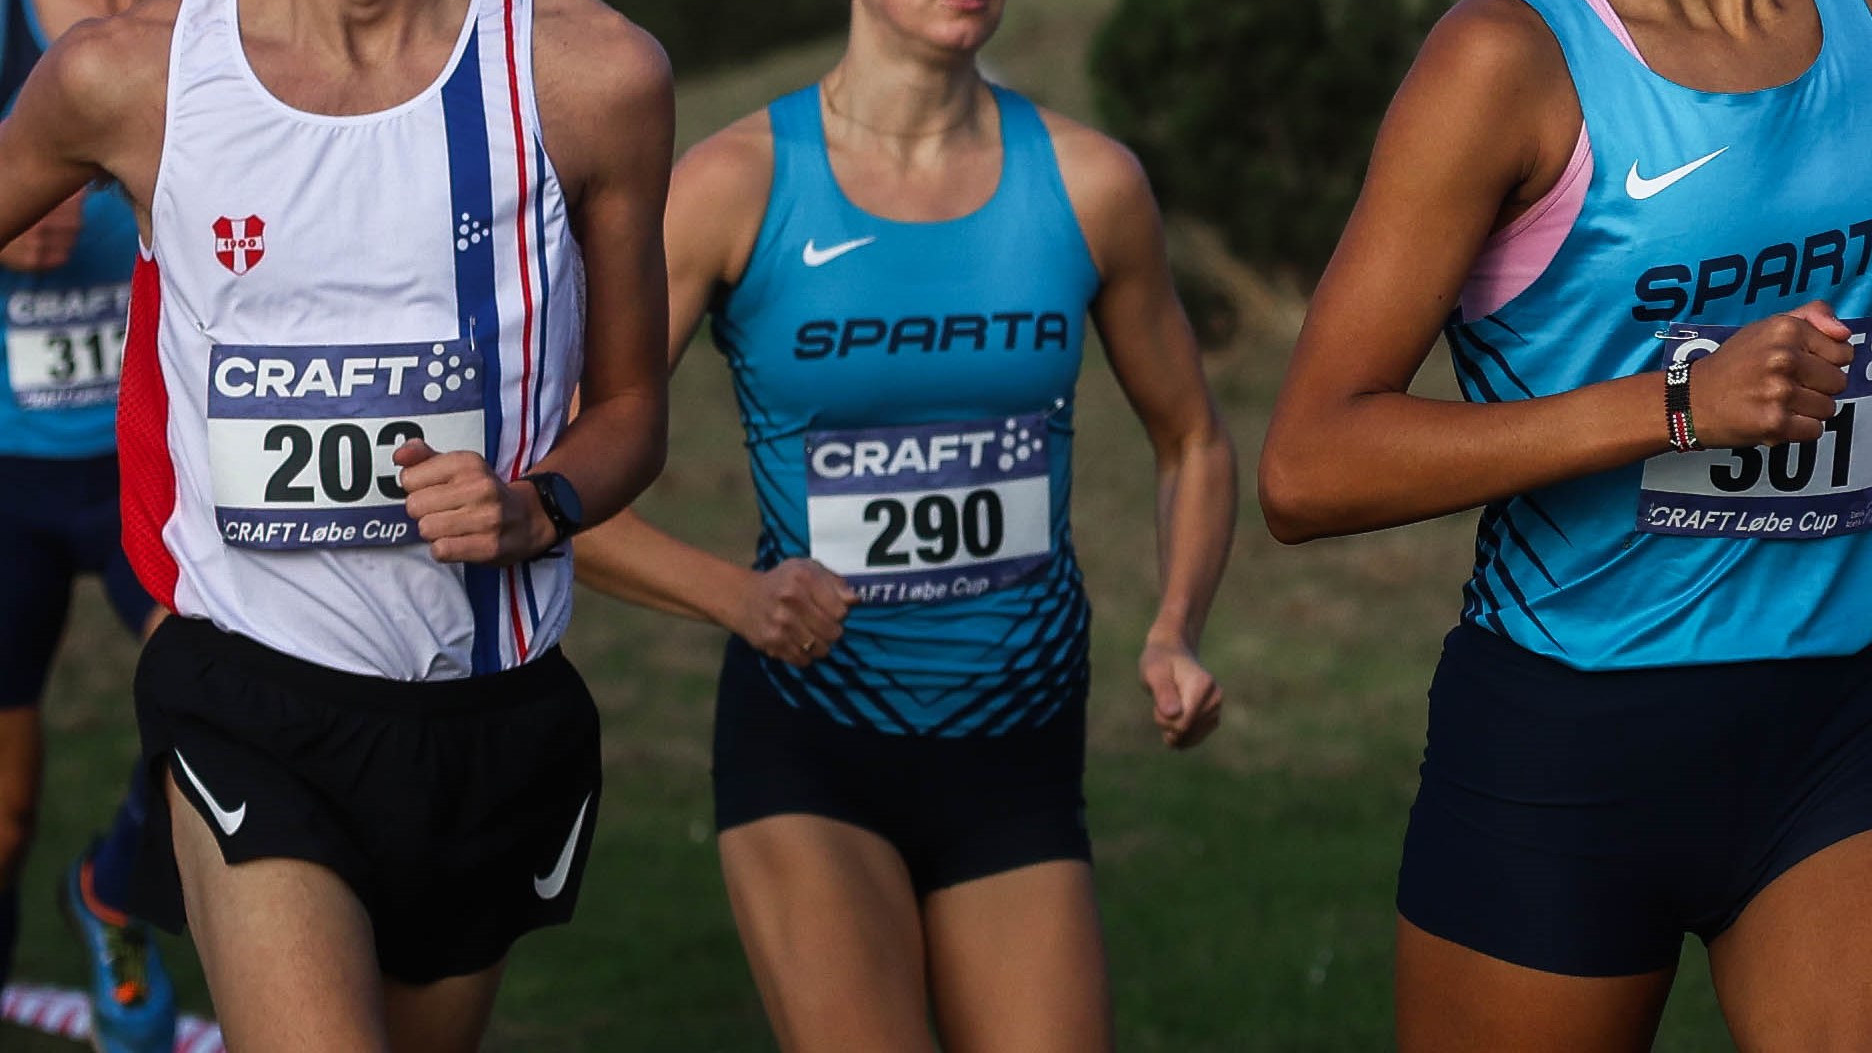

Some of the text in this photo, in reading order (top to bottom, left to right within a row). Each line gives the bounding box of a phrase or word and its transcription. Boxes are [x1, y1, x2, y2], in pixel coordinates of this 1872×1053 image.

[793, 310, 1068, 361] SPARTA
[214, 356, 419, 398] CRAFT
[263, 420, 425, 503] 203
[811, 430, 996, 479] CRAFT
[225, 519, 408, 543] CRAFT Løbe Cup
[863, 488, 1005, 569] 290
[1650, 505, 1735, 532] CRAFT
[1735, 507, 1794, 533] Løbe
[1799, 510, 1839, 533] Cup
[951, 575, 990, 597] Cup
